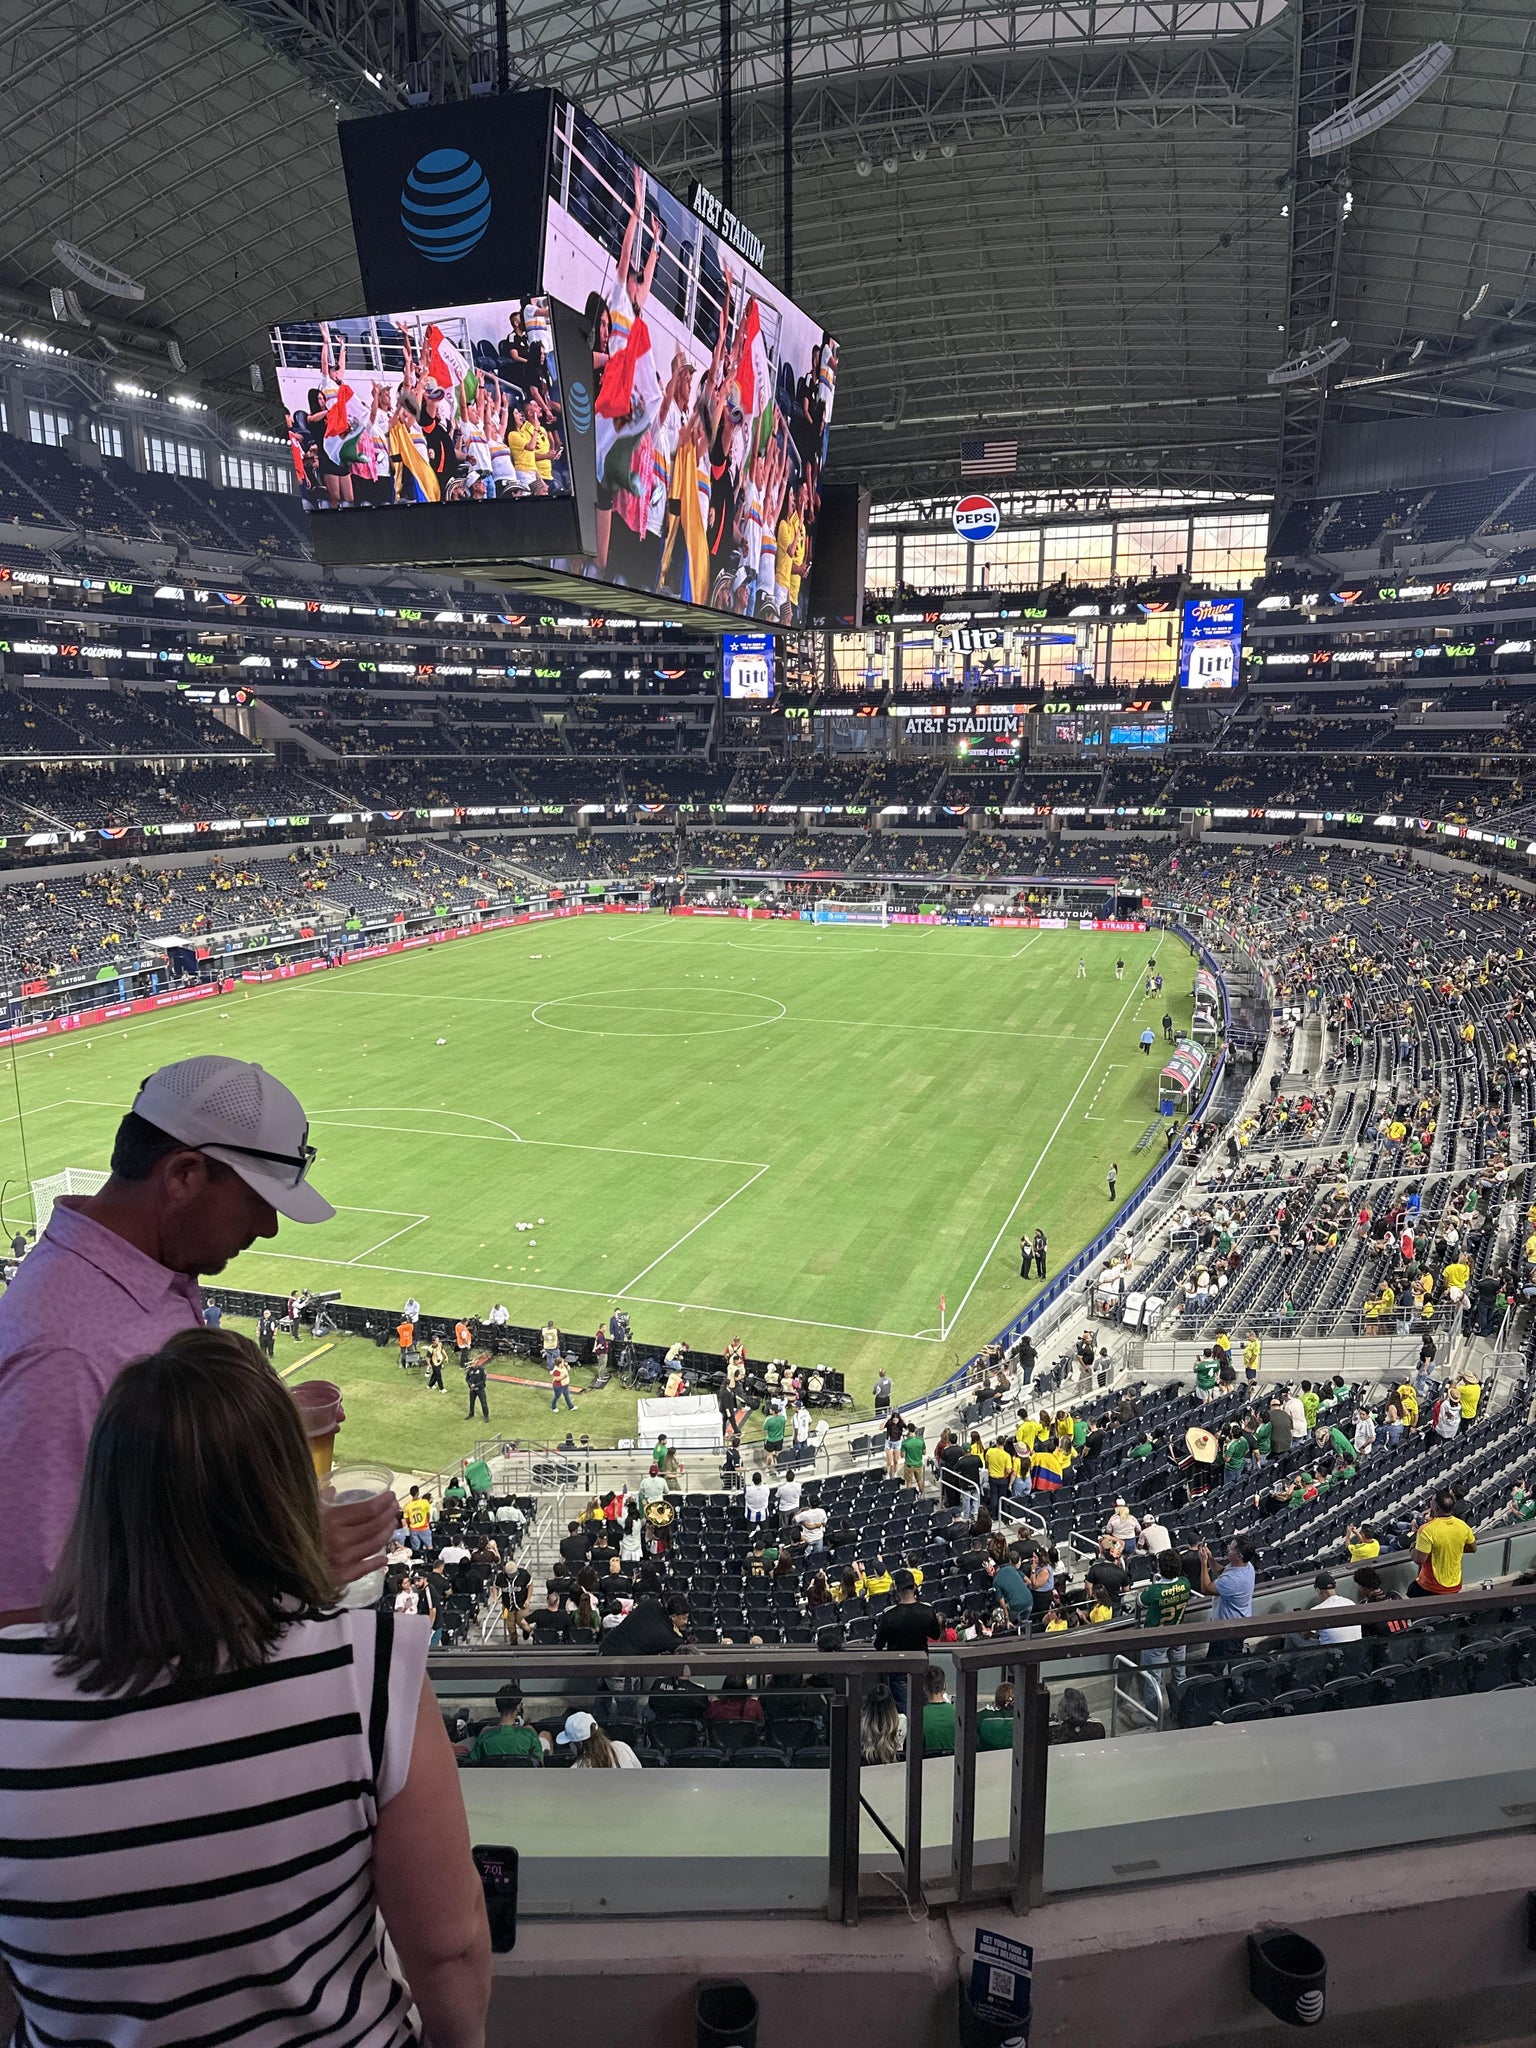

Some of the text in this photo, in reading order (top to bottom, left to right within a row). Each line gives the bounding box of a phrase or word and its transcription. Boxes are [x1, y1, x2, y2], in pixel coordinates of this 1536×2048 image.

[693, 183, 766, 270] AT&T STADIUM
[955, 512, 997, 525] PEPSI
[1436, 582, 1452, 595] VS
[194, 590, 209, 603] VS
[1302, 593, 1319, 605] VS
[306, 601, 320, 613] VS
[1110, 604, 1127, 615] VS
[1192, 603, 1235, 622] Miller
[473, 613, 488, 624] VS
[925, 612, 939, 622] VS
[590, 619, 604, 628] VS
[950, 628, 999, 655] Lite
[60, 645, 79, 656] VS
[282, 658, 298, 669] VS
[1312, 653, 1331, 663] VS
[418, 665, 434, 675] VS
[624, 670, 641, 679] VS
[813, 708, 854, 716] MEXTOUR
[990, 705, 1009, 714] COL
[1075, 703, 1122, 712] MEXTOUR
[906, 716, 1018, 734] AT&T STADIUM
[455, 807, 466, 816] VS
[614, 804, 628, 813] VS
[754, 804, 768, 813] VS
[917, 806, 932, 815] VS
[1036, 806, 1051, 815] VS
[1250, 809, 1265, 819] VS
[360, 812, 373, 823] VS
[196, 821, 209, 833] VS
[69, 830, 87, 843] VS
[1102, 922, 1135, 930] STRAUSS
[140, 960, 153, 968] AT&T
[1208, 1368, 1214, 1377] 4
[412, 1512, 423, 1525] 10
[1161, 1584, 1185, 1597] crefisa
[1160, 1602, 1188, 1627] 27
[483, 1864, 502, 1875] 7:01
[979, 1942, 999, 1956] DRINKS
[982, 1935, 993, 1943] GET
[994, 1938, 1008, 1950] YOUR
[1008, 1943, 1022, 1954] FOOD
